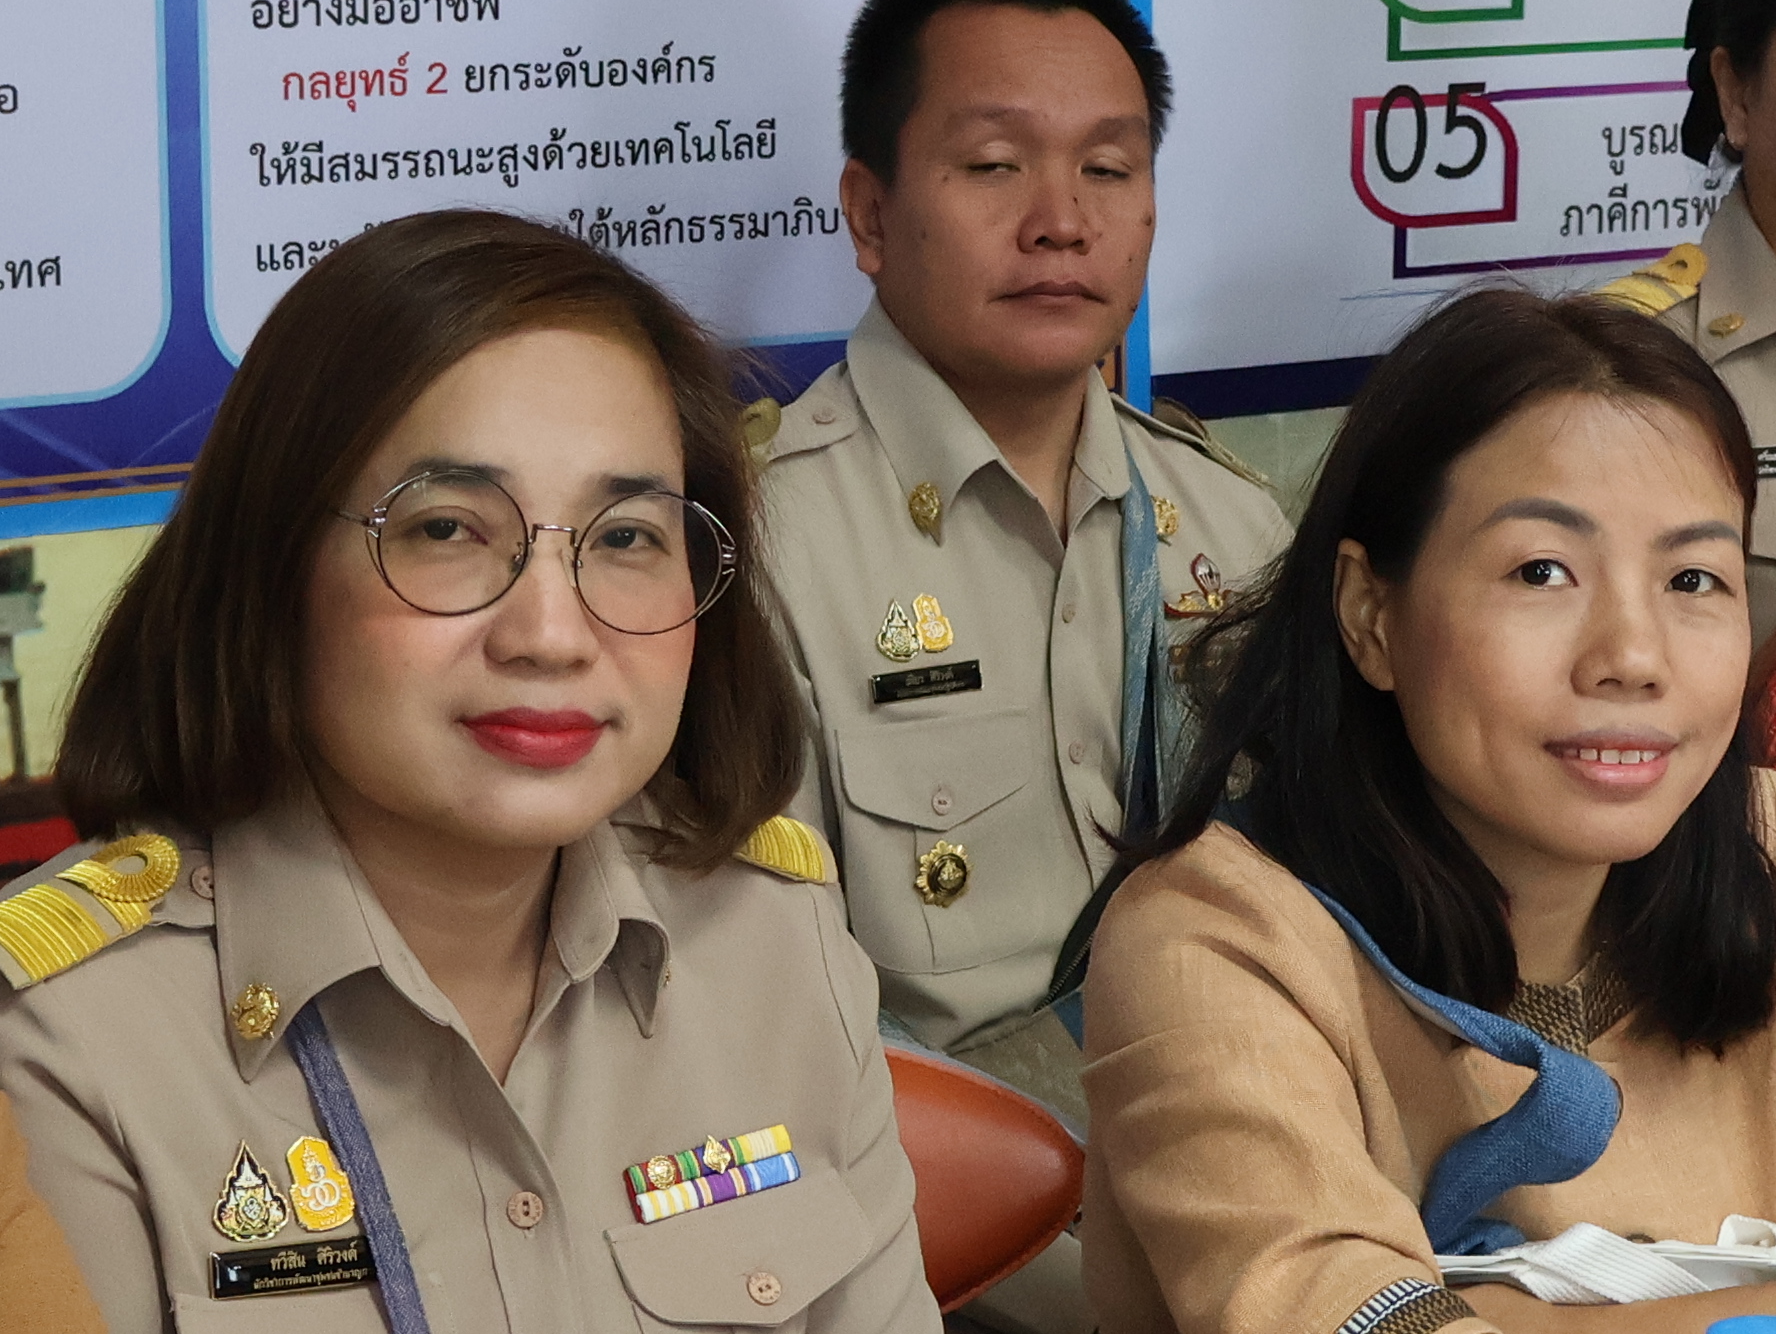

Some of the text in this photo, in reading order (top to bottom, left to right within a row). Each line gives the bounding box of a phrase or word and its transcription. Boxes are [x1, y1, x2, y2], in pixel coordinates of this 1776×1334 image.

[282, 42, 717, 114] กลยุทธ์ 2 ยกระดับองค์กร
[249, 119, 777, 193] ให้มีสมรรถนะสูงด้วยเทคโนโลยี
[1375, 83, 1488, 184] 05
